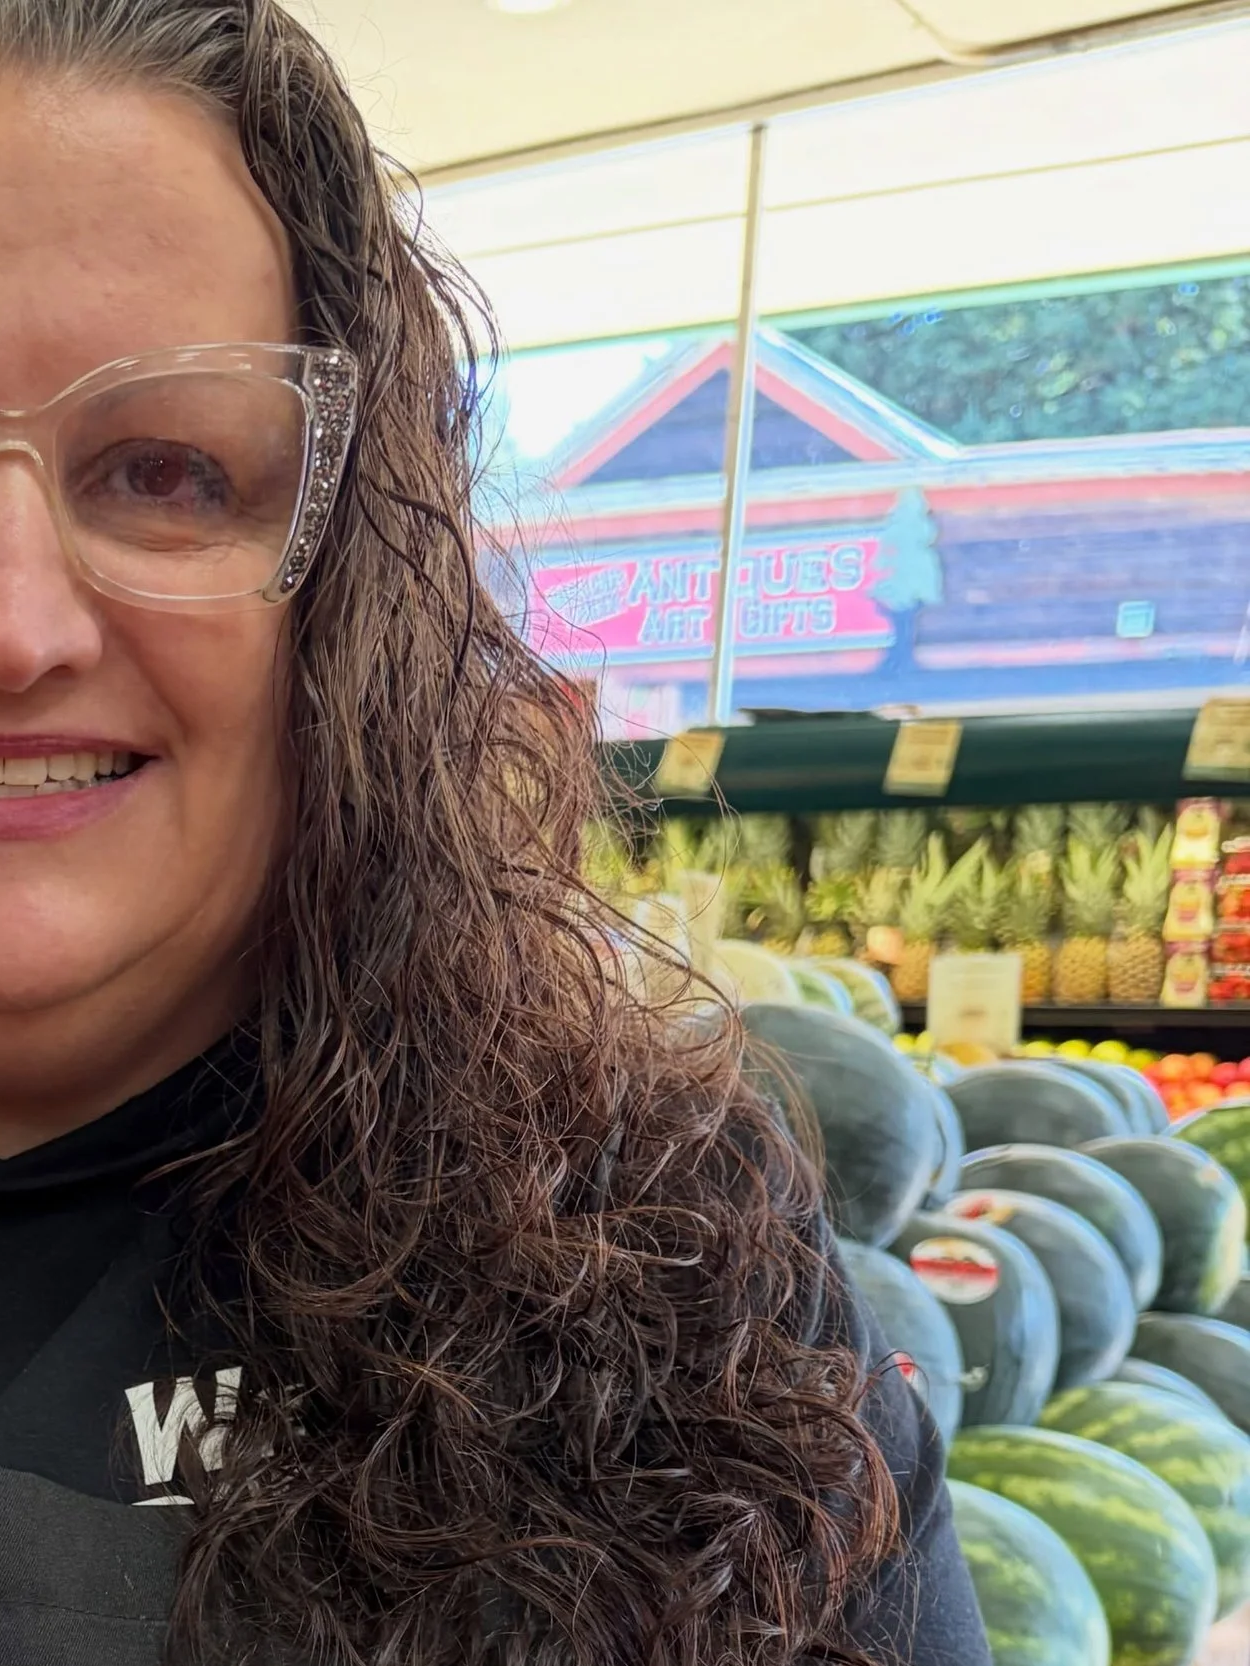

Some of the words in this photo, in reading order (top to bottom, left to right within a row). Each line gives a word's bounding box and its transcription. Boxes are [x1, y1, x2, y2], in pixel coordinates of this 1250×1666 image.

[628, 545, 867, 606] ANTQUES
[638, 604, 711, 645] ART
[738, 594, 836, 639] GIFTS
